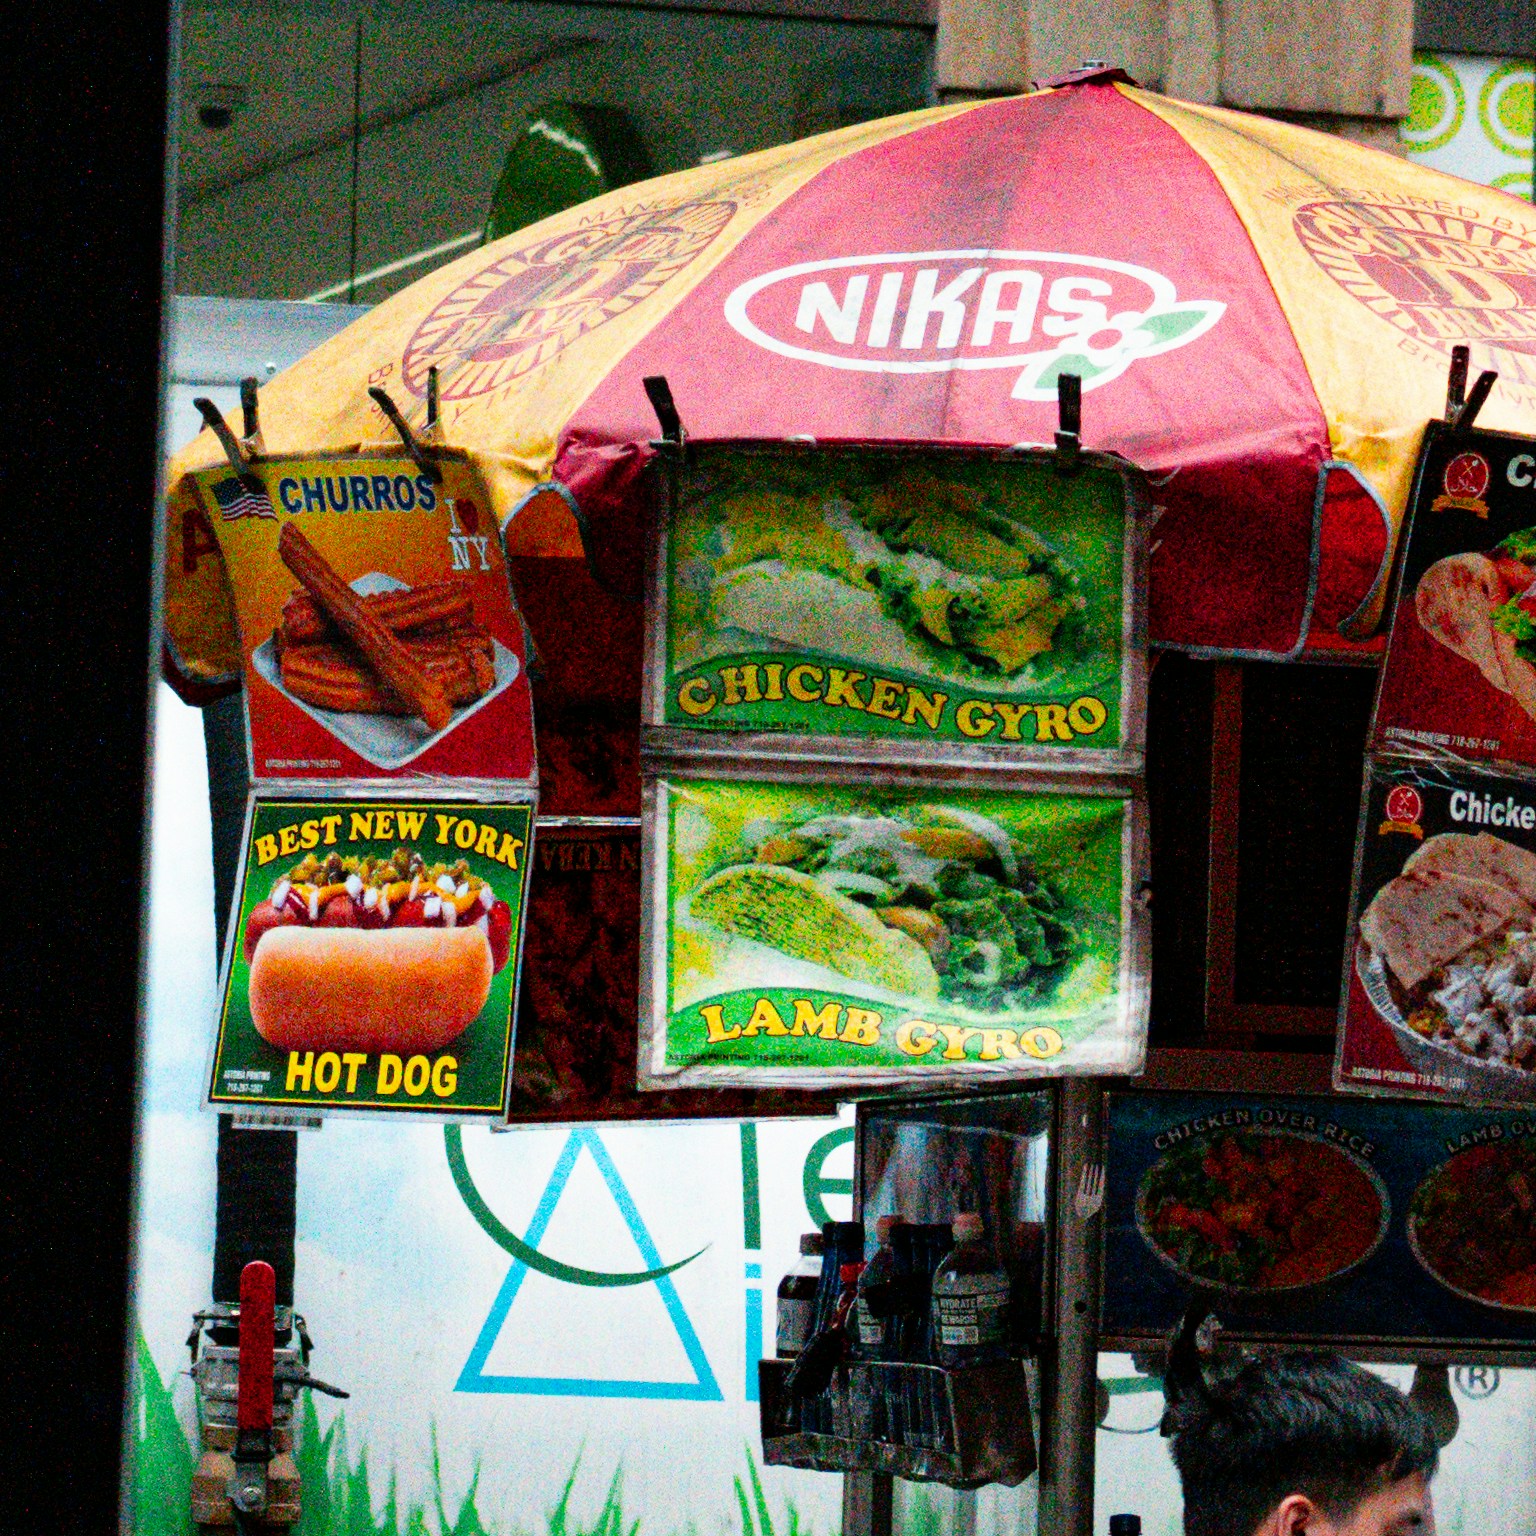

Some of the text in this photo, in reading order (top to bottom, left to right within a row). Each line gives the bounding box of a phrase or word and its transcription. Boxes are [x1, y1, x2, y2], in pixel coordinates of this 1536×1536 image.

[794, 266, 1113, 351] NIKAS
[278, 474, 437, 514] CHURROS
[444, 498, 461, 534] I
[448, 536, 491, 571] NY
[677, 662, 1109, 742] CHICKEN GYRO
[253, 811, 525, 871] BEST NEW YORK
[699, 997, 1064, 1061] LAMB GYRO
[285, 1051, 459, 1097] HOT DOG
[1153, 1107, 1378, 1160] CHICKEN OVER RICE
[1445, 1122, 1508, 1154] LAMB
